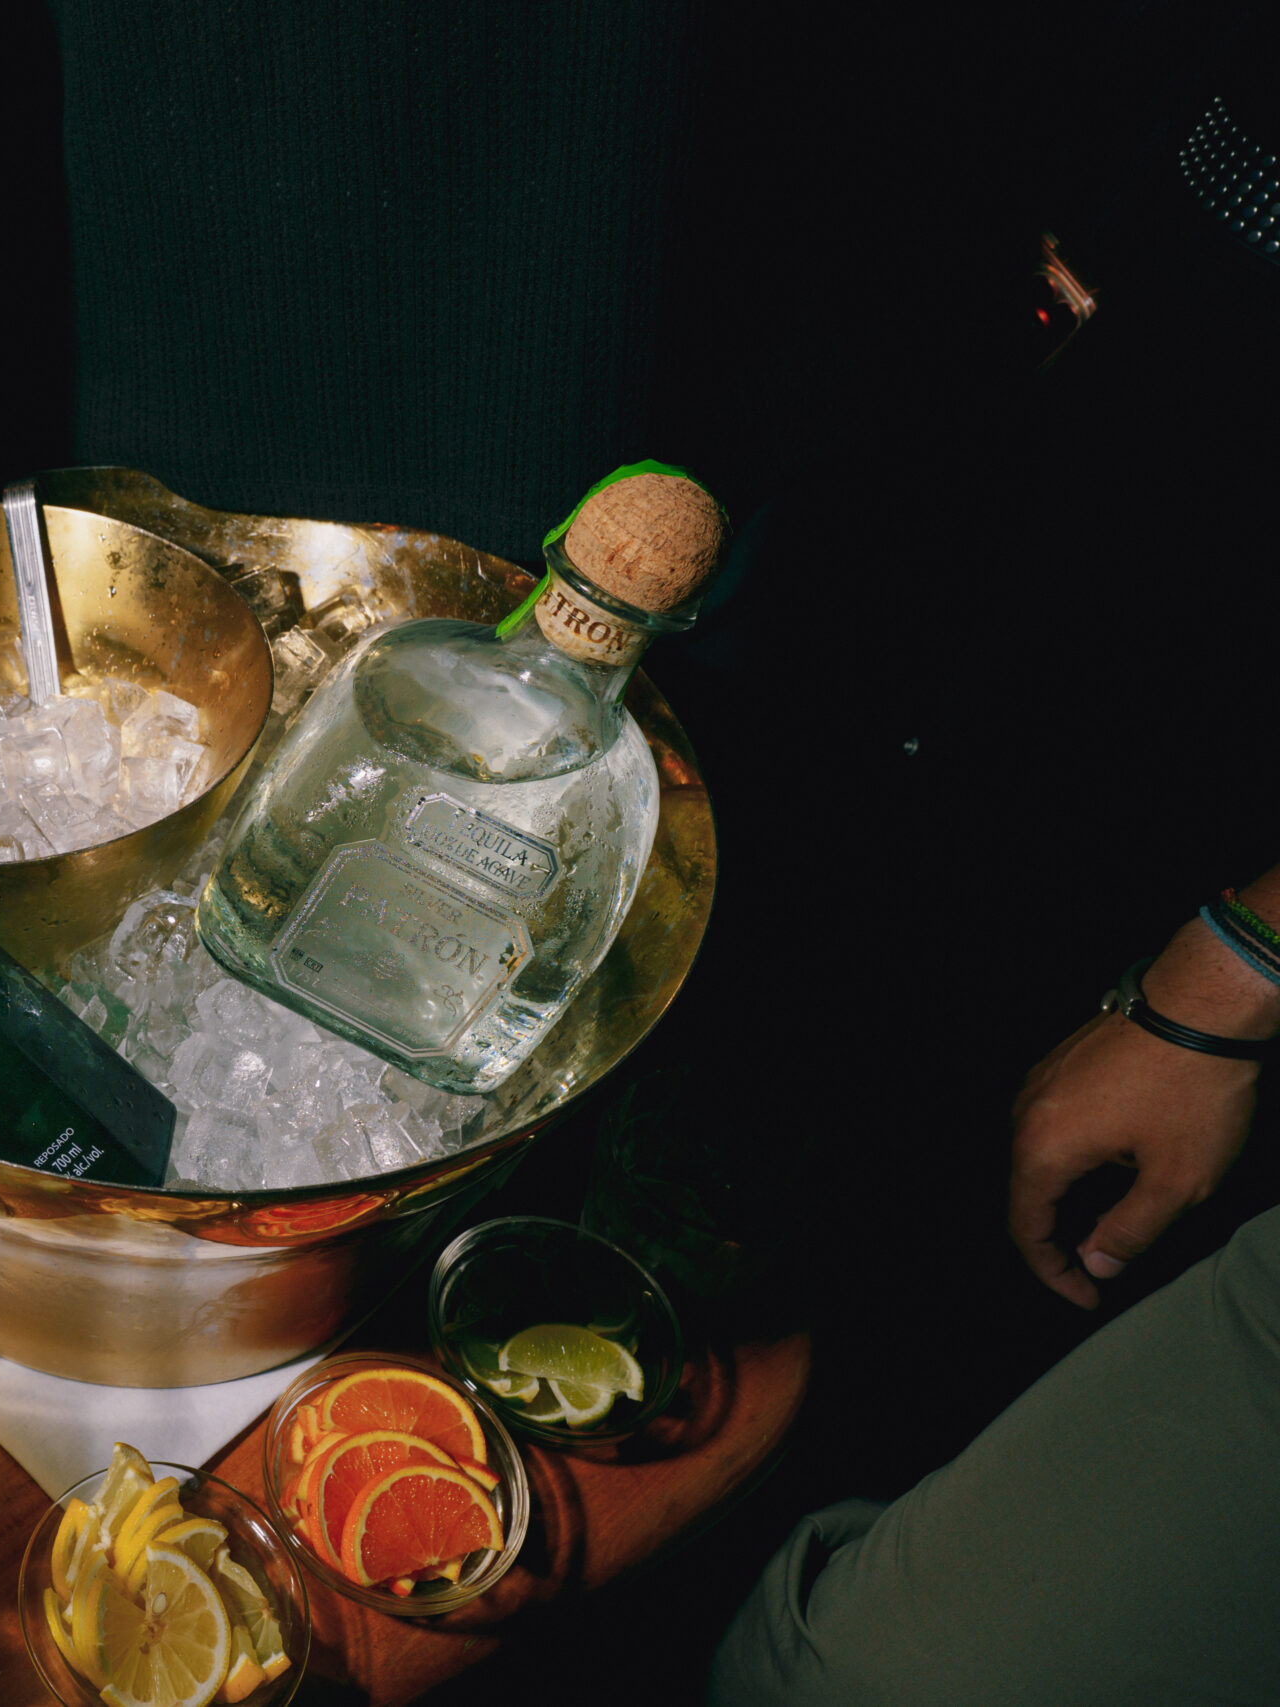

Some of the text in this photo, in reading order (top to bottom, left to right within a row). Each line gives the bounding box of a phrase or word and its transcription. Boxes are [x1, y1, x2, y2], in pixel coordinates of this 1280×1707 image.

[476, 856, 532, 890] AGAVE
[33, 1127, 75, 1167] REPOSADO
[51, 1142, 83, 1172] 700 ml
